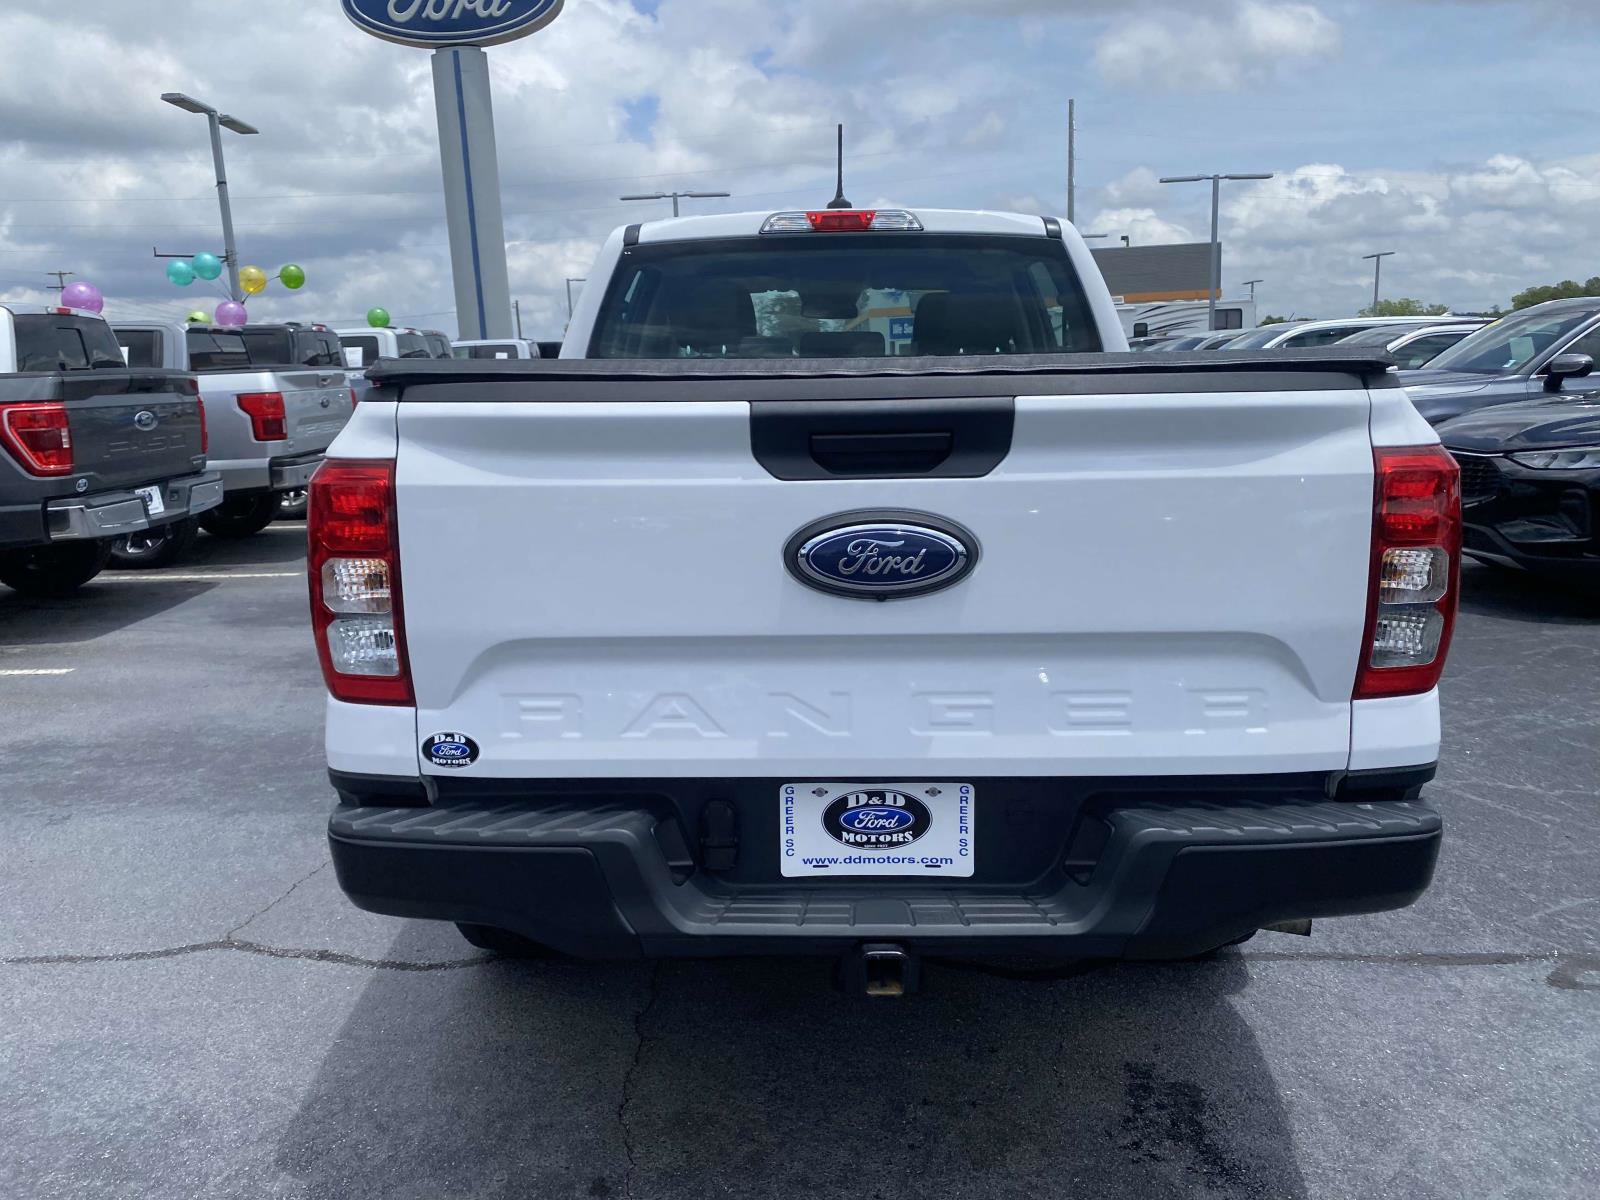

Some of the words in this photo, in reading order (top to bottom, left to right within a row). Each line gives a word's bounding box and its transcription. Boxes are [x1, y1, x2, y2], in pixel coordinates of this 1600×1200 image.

[838, 538, 927, 575] Ford
[500, 688, 1268, 738] RANGER
[434, 734, 466, 744] D&D
[438, 745, 462, 756] Ford
[431, 756, 471, 765] MOTORS
[846, 792, 906, 809] D&D
[785, 786, 794, 835] GREER
[959, 785, 969, 835] GREER
[854, 811, 899, 828] Ford
[841, 831, 914, 844] MOTORS
[785, 838, 795, 857] SC
[959, 838, 969, 857] SC
[802, 855, 953, 865] www.ddmotors.com
